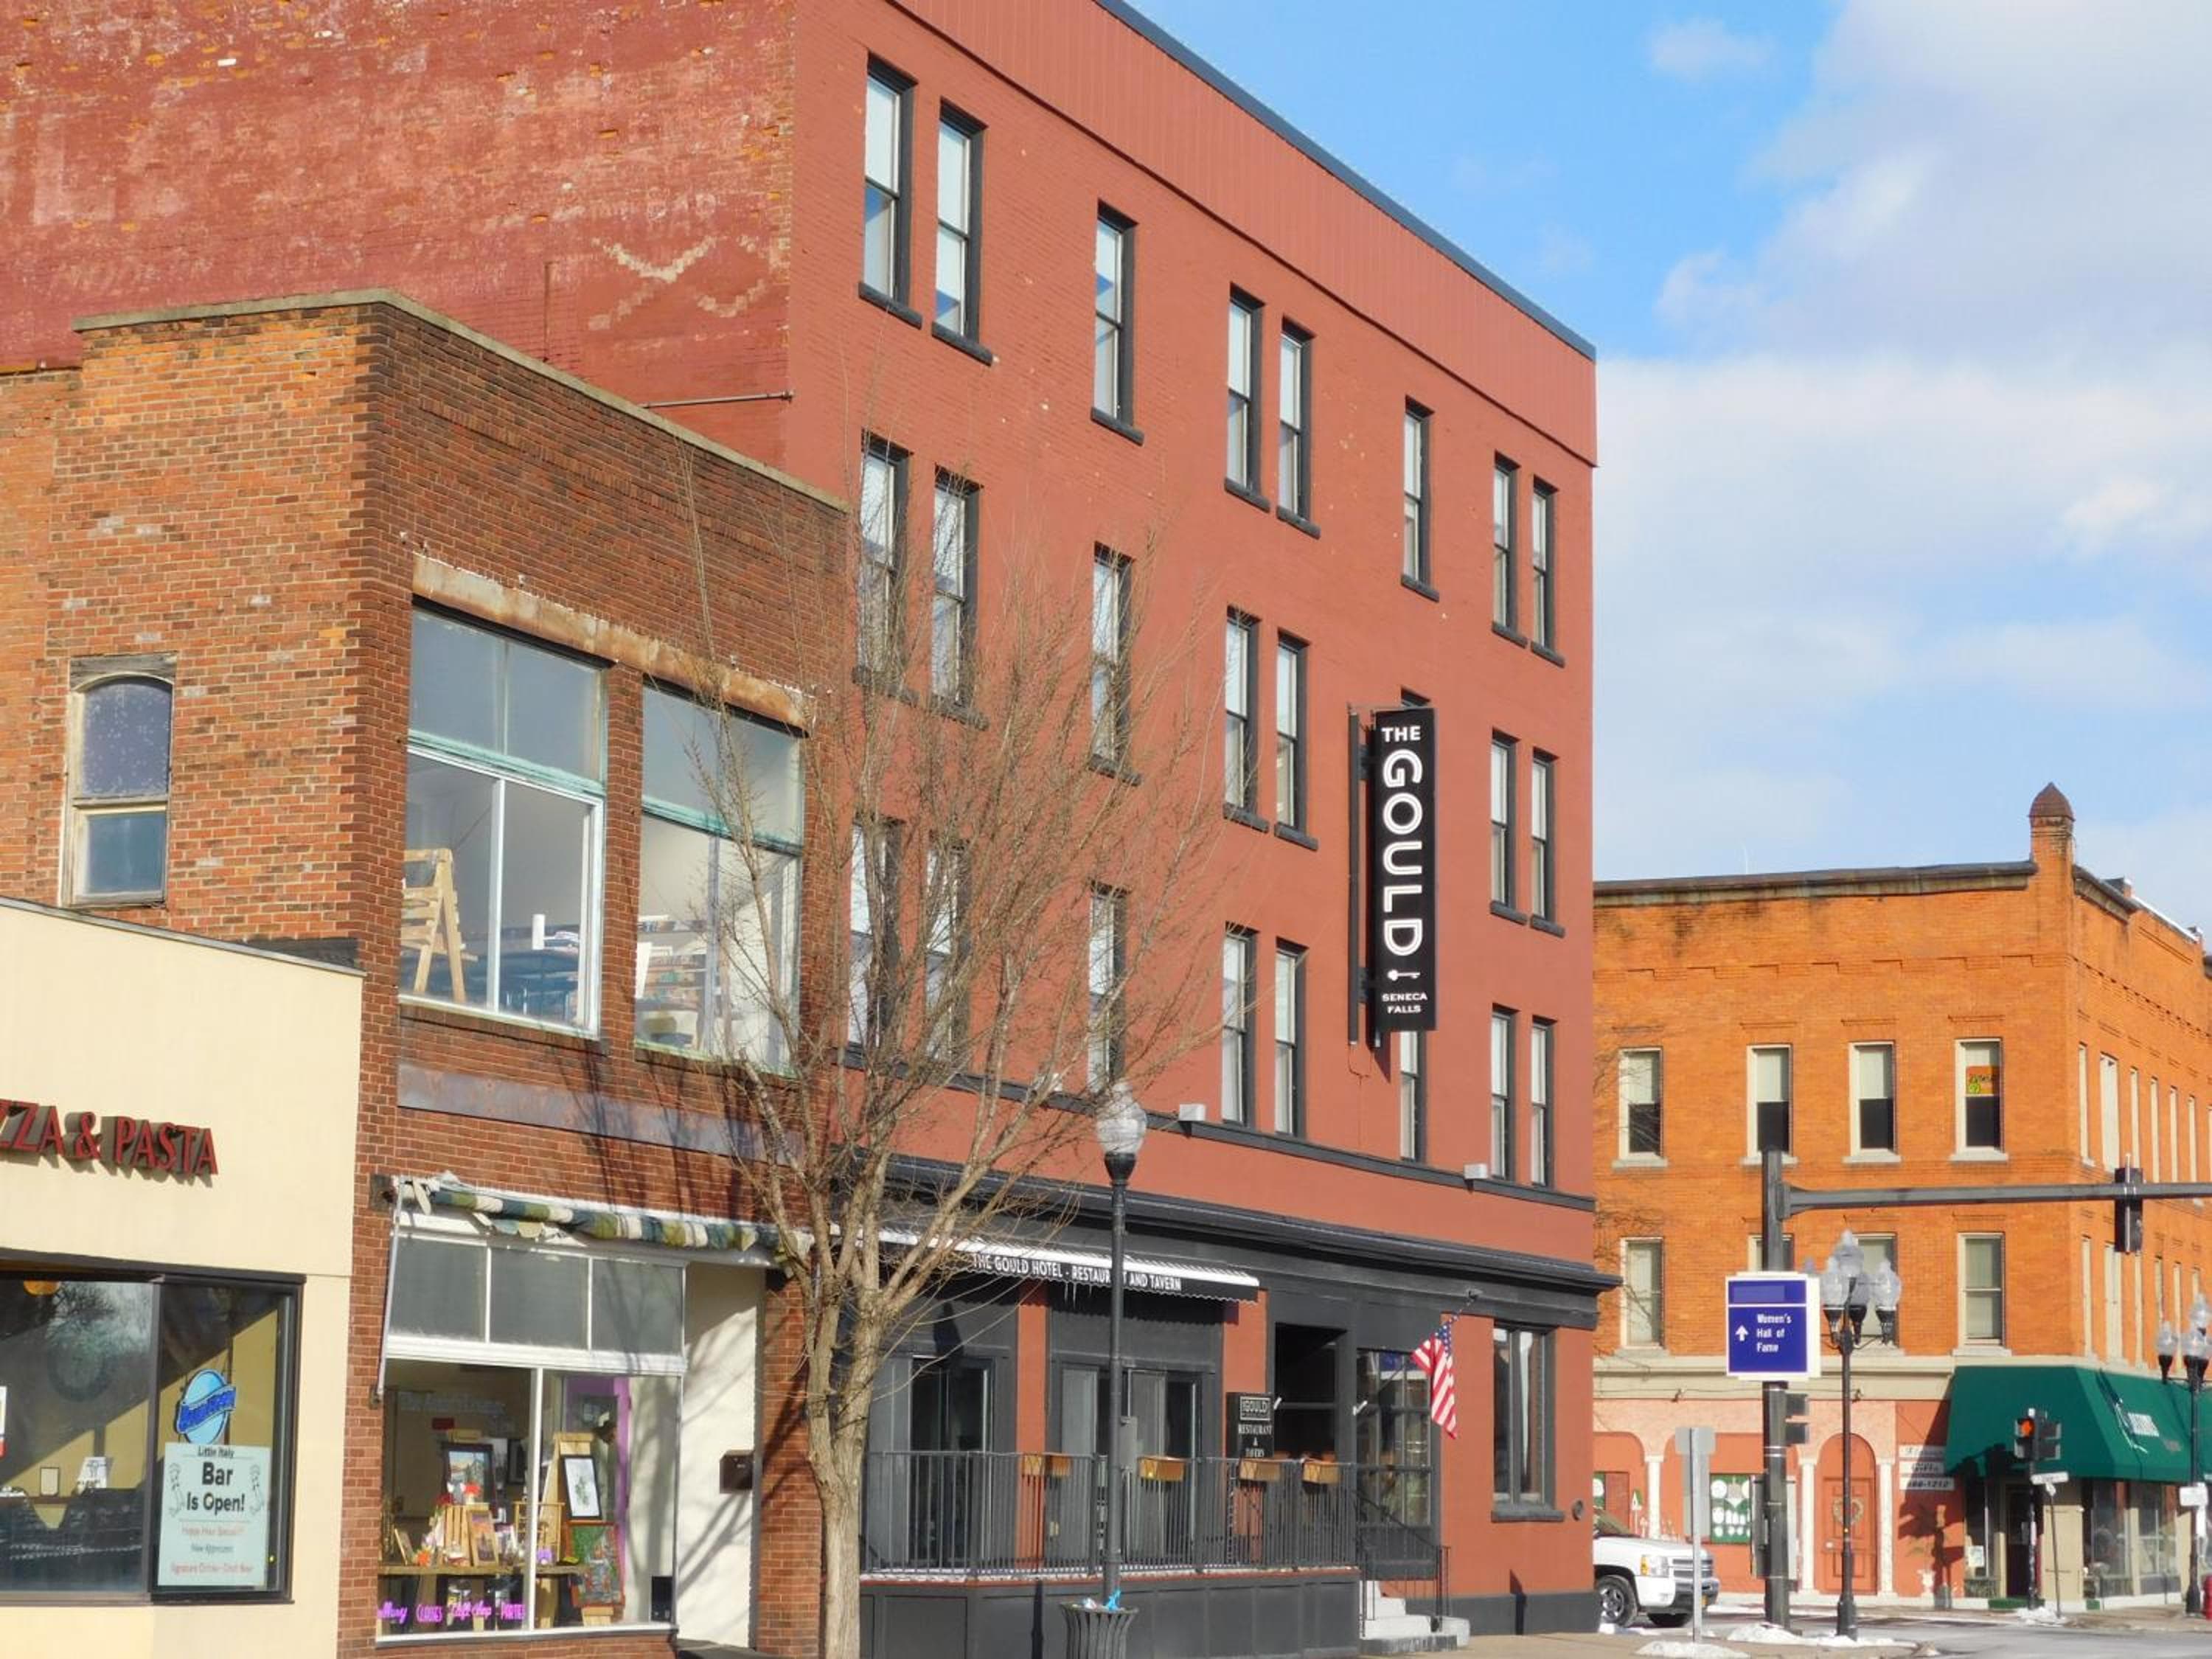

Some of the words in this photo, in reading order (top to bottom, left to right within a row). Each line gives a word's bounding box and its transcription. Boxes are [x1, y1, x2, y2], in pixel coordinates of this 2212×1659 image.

[1381, 726, 1421, 742] THE
[1382, 749, 1423, 956] GOULD
[1382, 992, 1428, 1002] SENECA
[1388, 1005, 1421, 1014] FALLS
[75, 1111, 102, 1160] &
[114, 1116, 219, 1175] PASTA
[973, 1253, 992, 1270] THE
[995, 1256, 1029, 1274] GOULD
[1032, 1261, 1063, 1279] HOTEL
[1071, 1265, 1127, 1286] RESTAURT
[1129, 1276, 1149, 1289] AND
[1150, 1279, 1183, 1291] TAVERN
[1756, 1313, 1792, 1324] Women's
[1756, 1328, 1773, 1338] Hall
[1775, 1328, 1785, 1338] of
[1756, 1342, 1779, 1352] Fame
[197, 1446, 217, 1457] Little
[218, 1446, 234, 1459] Italy
[201, 1461, 233, 1485] Bar
[187, 1492, 199, 1510] Is
[203, 1492, 246, 1516] Open!
